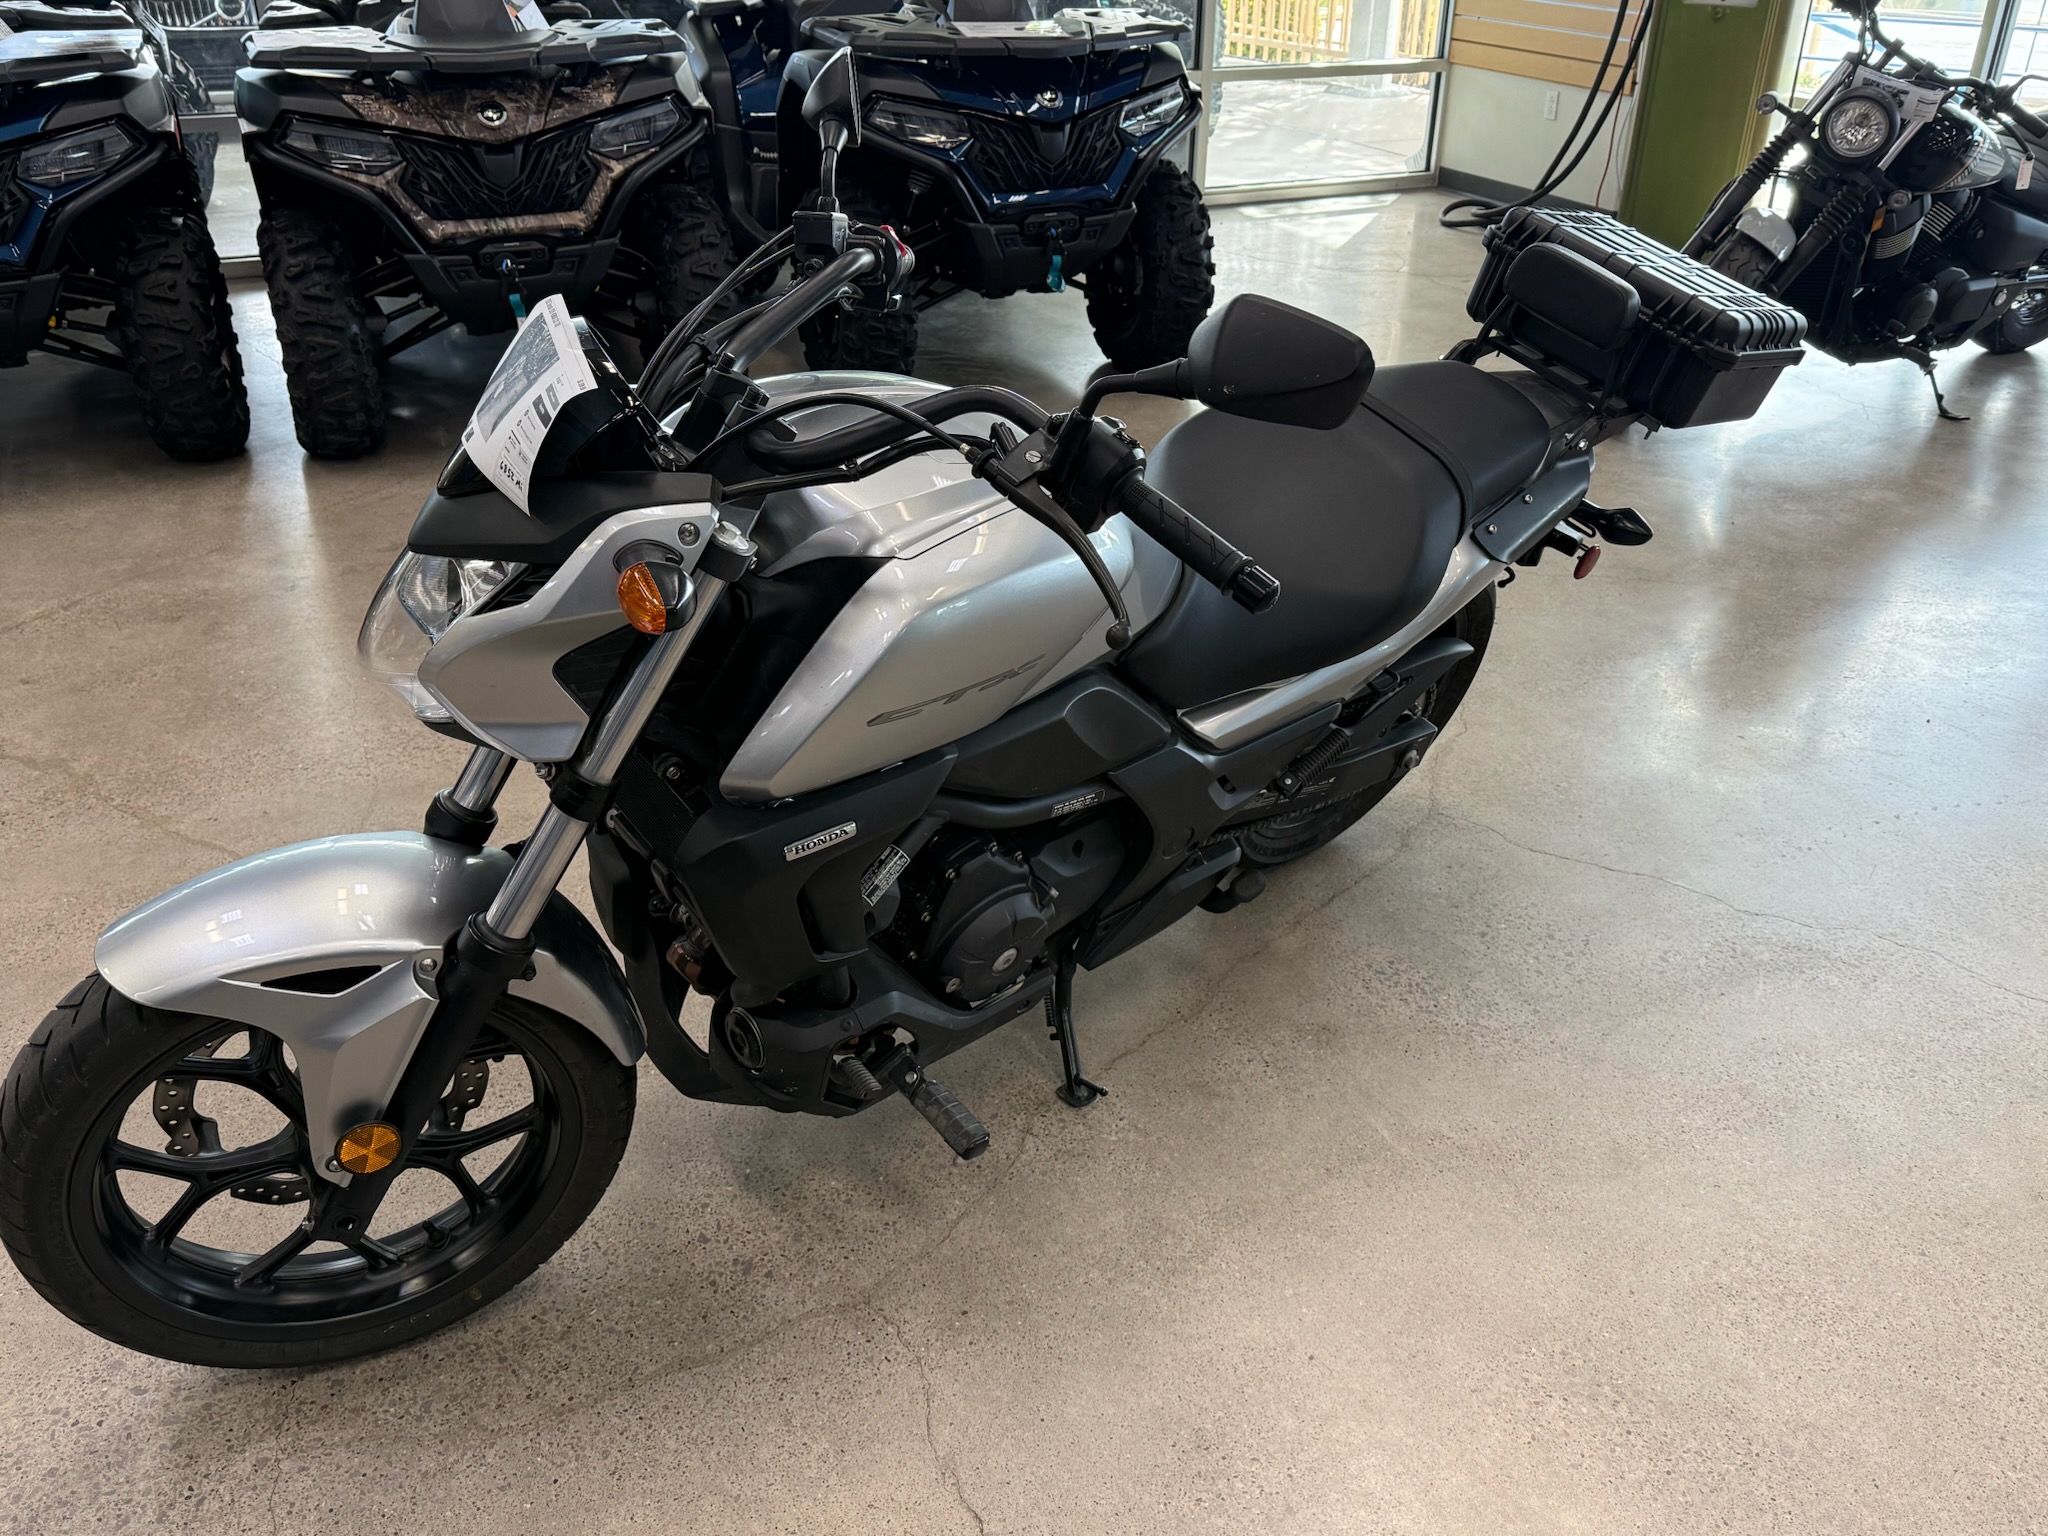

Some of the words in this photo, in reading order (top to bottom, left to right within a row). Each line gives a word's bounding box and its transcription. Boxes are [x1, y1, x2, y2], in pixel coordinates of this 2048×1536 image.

[500, 461, 515, 482] 6852
[866, 653, 1046, 727] CTX
[794, 828, 849, 855] HONDA
